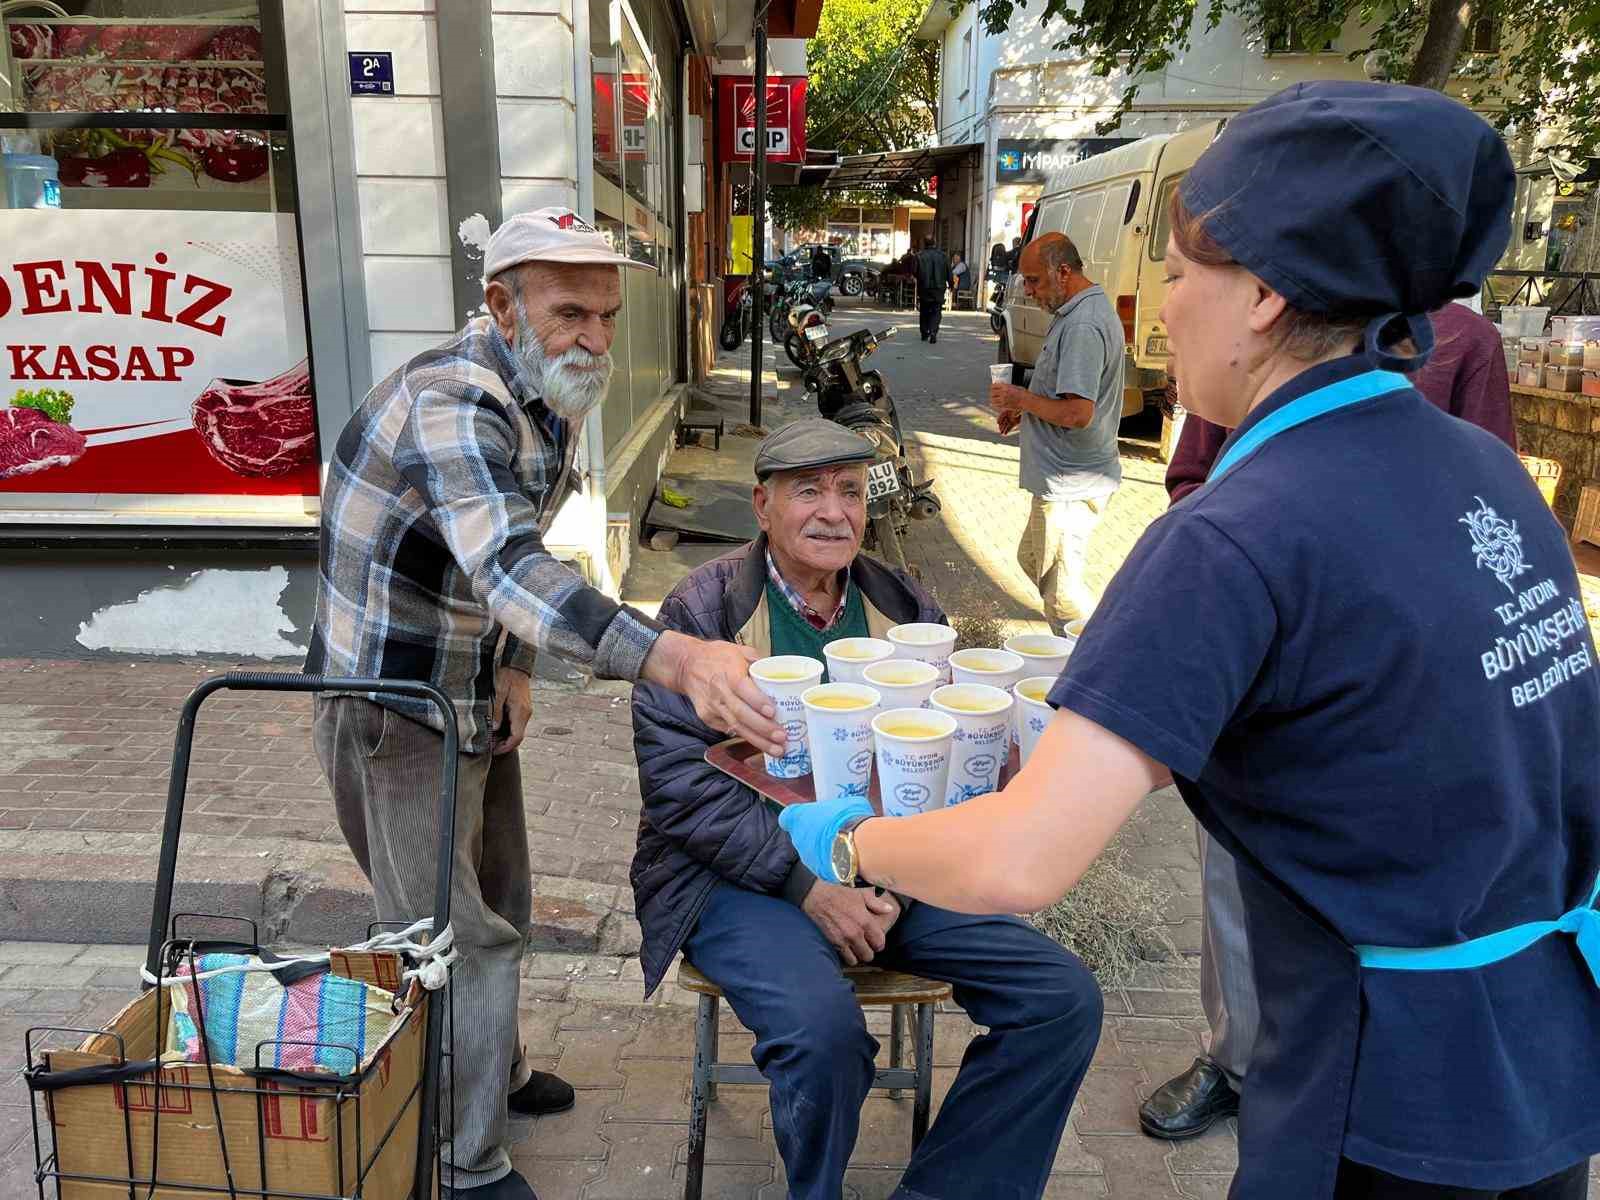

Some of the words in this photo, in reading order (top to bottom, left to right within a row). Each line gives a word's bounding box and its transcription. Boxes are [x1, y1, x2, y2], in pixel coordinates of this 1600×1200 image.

[0, 251, 233, 337] ENİZ
[6, 344, 195, 381] KASAP
[869, 478, 897, 496] 892
[1511, 641, 1593, 708] BELEDİYESİ
